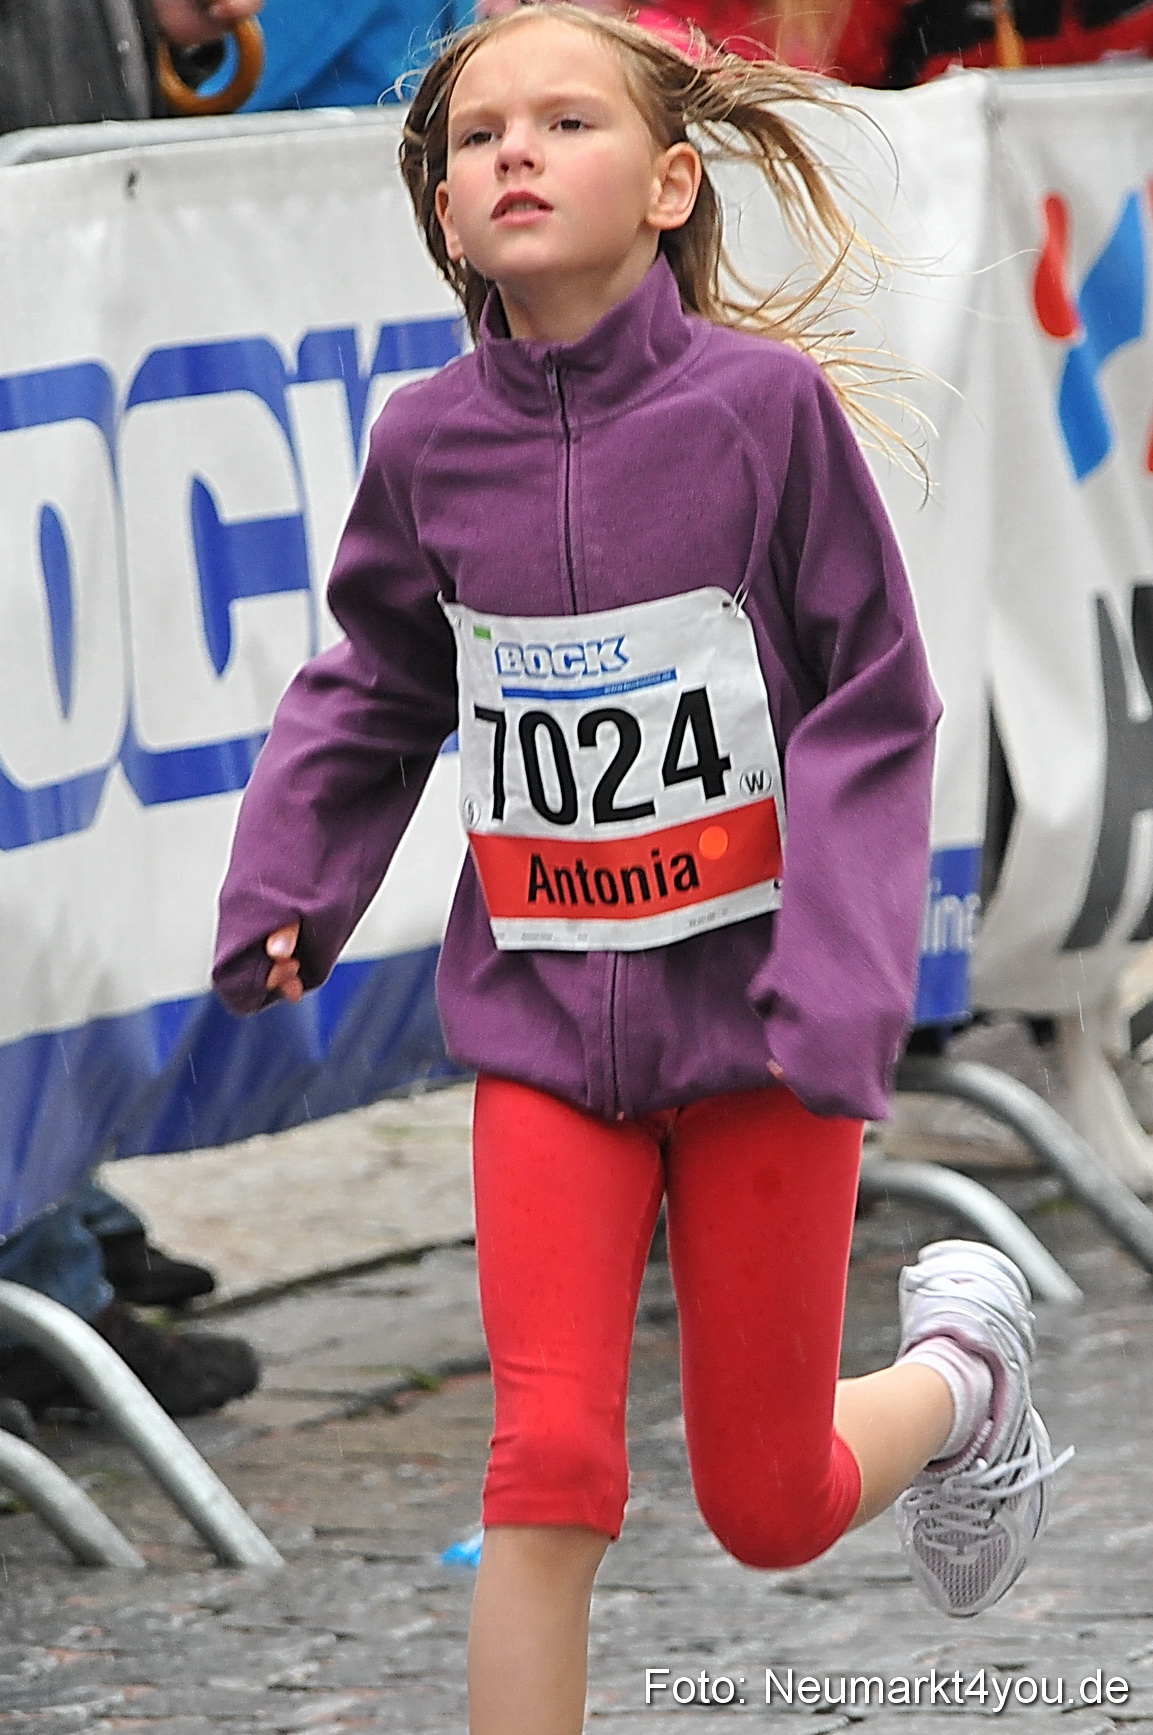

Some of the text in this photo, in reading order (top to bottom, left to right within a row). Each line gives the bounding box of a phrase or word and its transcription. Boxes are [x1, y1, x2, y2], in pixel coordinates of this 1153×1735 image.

[494, 634, 630, 678] BOCK
[474, 686, 732, 825] 7024
[527, 848, 700, 905] Antonia
